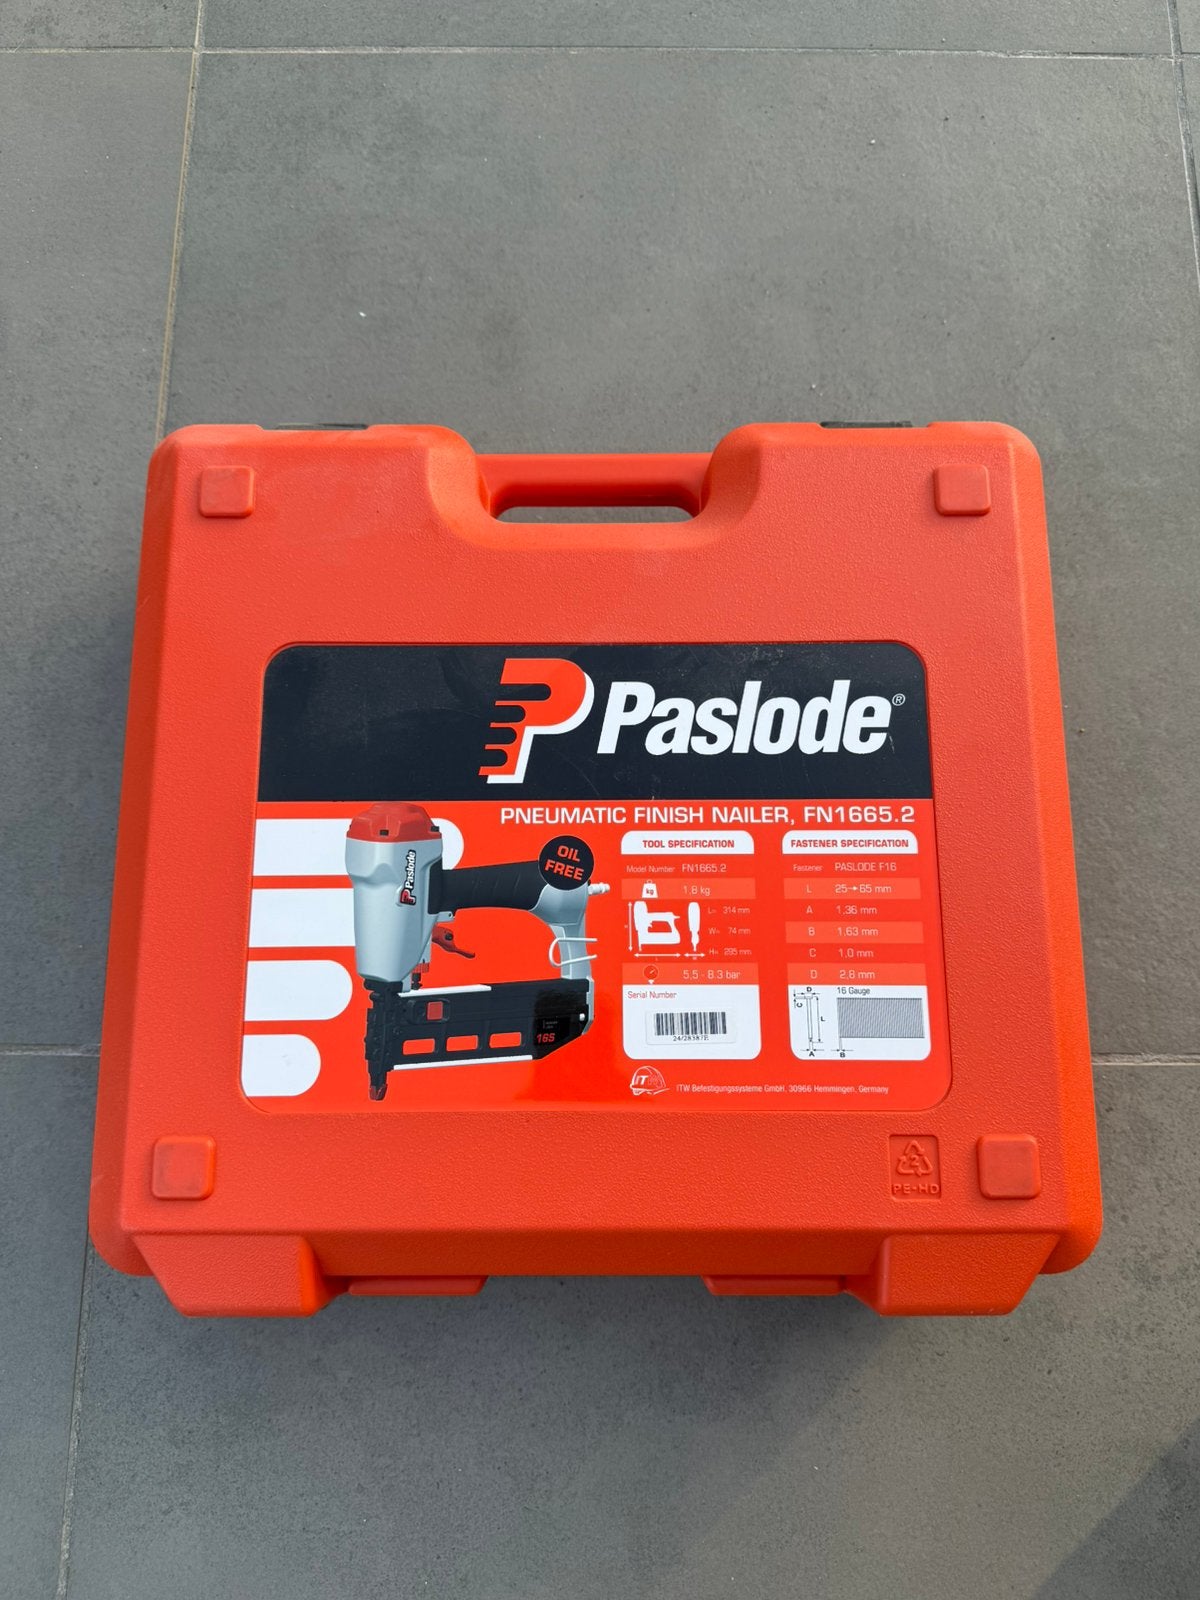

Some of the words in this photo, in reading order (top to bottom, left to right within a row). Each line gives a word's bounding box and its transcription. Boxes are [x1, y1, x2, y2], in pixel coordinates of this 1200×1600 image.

[501, 807, 626, 824] PNEUMATIC
[634, 807, 704, 823] FINISH
[712, 806, 795, 825] NAILER,
[804, 805, 915, 823] FN1665.2
[642, 839, 665, 848] TOOL
[668, 839, 735, 848] SPECIFICATION
[791, 839, 838, 848] FASTENER
[840, 839, 909, 848] SPECIFICATION
[556, 845, 581, 862] OIL
[405, 850, 416, 889] Paslode
[544, 859, 585, 881] FREE
[626, 865, 647, 873] Model
[648, 865, 675, 873] Number
[681, 863, 727, 873] FN1665.2
[834, 862, 876, 871] PASLODE
[879, 862, 897, 871] F16
[646, 887, 655, 896] kg
[700, 885, 711, 897] kg
[806, 884, 812, 893] L
[835, 884, 848, 893] 25
[859, 884, 872, 893] 65
[875, 885, 892, 893] mm
[723, 906, 736, 914] 314
[806, 906, 813, 914] A
[728, 927, 737, 935] 74
[809, 948, 817, 957] C
[725, 969, 741, 980] bar
[858, 971, 876, 979] mm
[627, 990, 648, 999] Serial
[649, 990, 677, 999] Number
[837, 986, 847, 994] 16
[848, 986, 870, 995] Gauge
[676, 1084, 691, 1092] ITW
[692, 1084, 763, 1094] Befestigungssysteme
[789, 1084, 812, 1093] 30966
[858, 1085, 889, 1094] Germany
[892, 1183, 940, 1195] PE-HD
